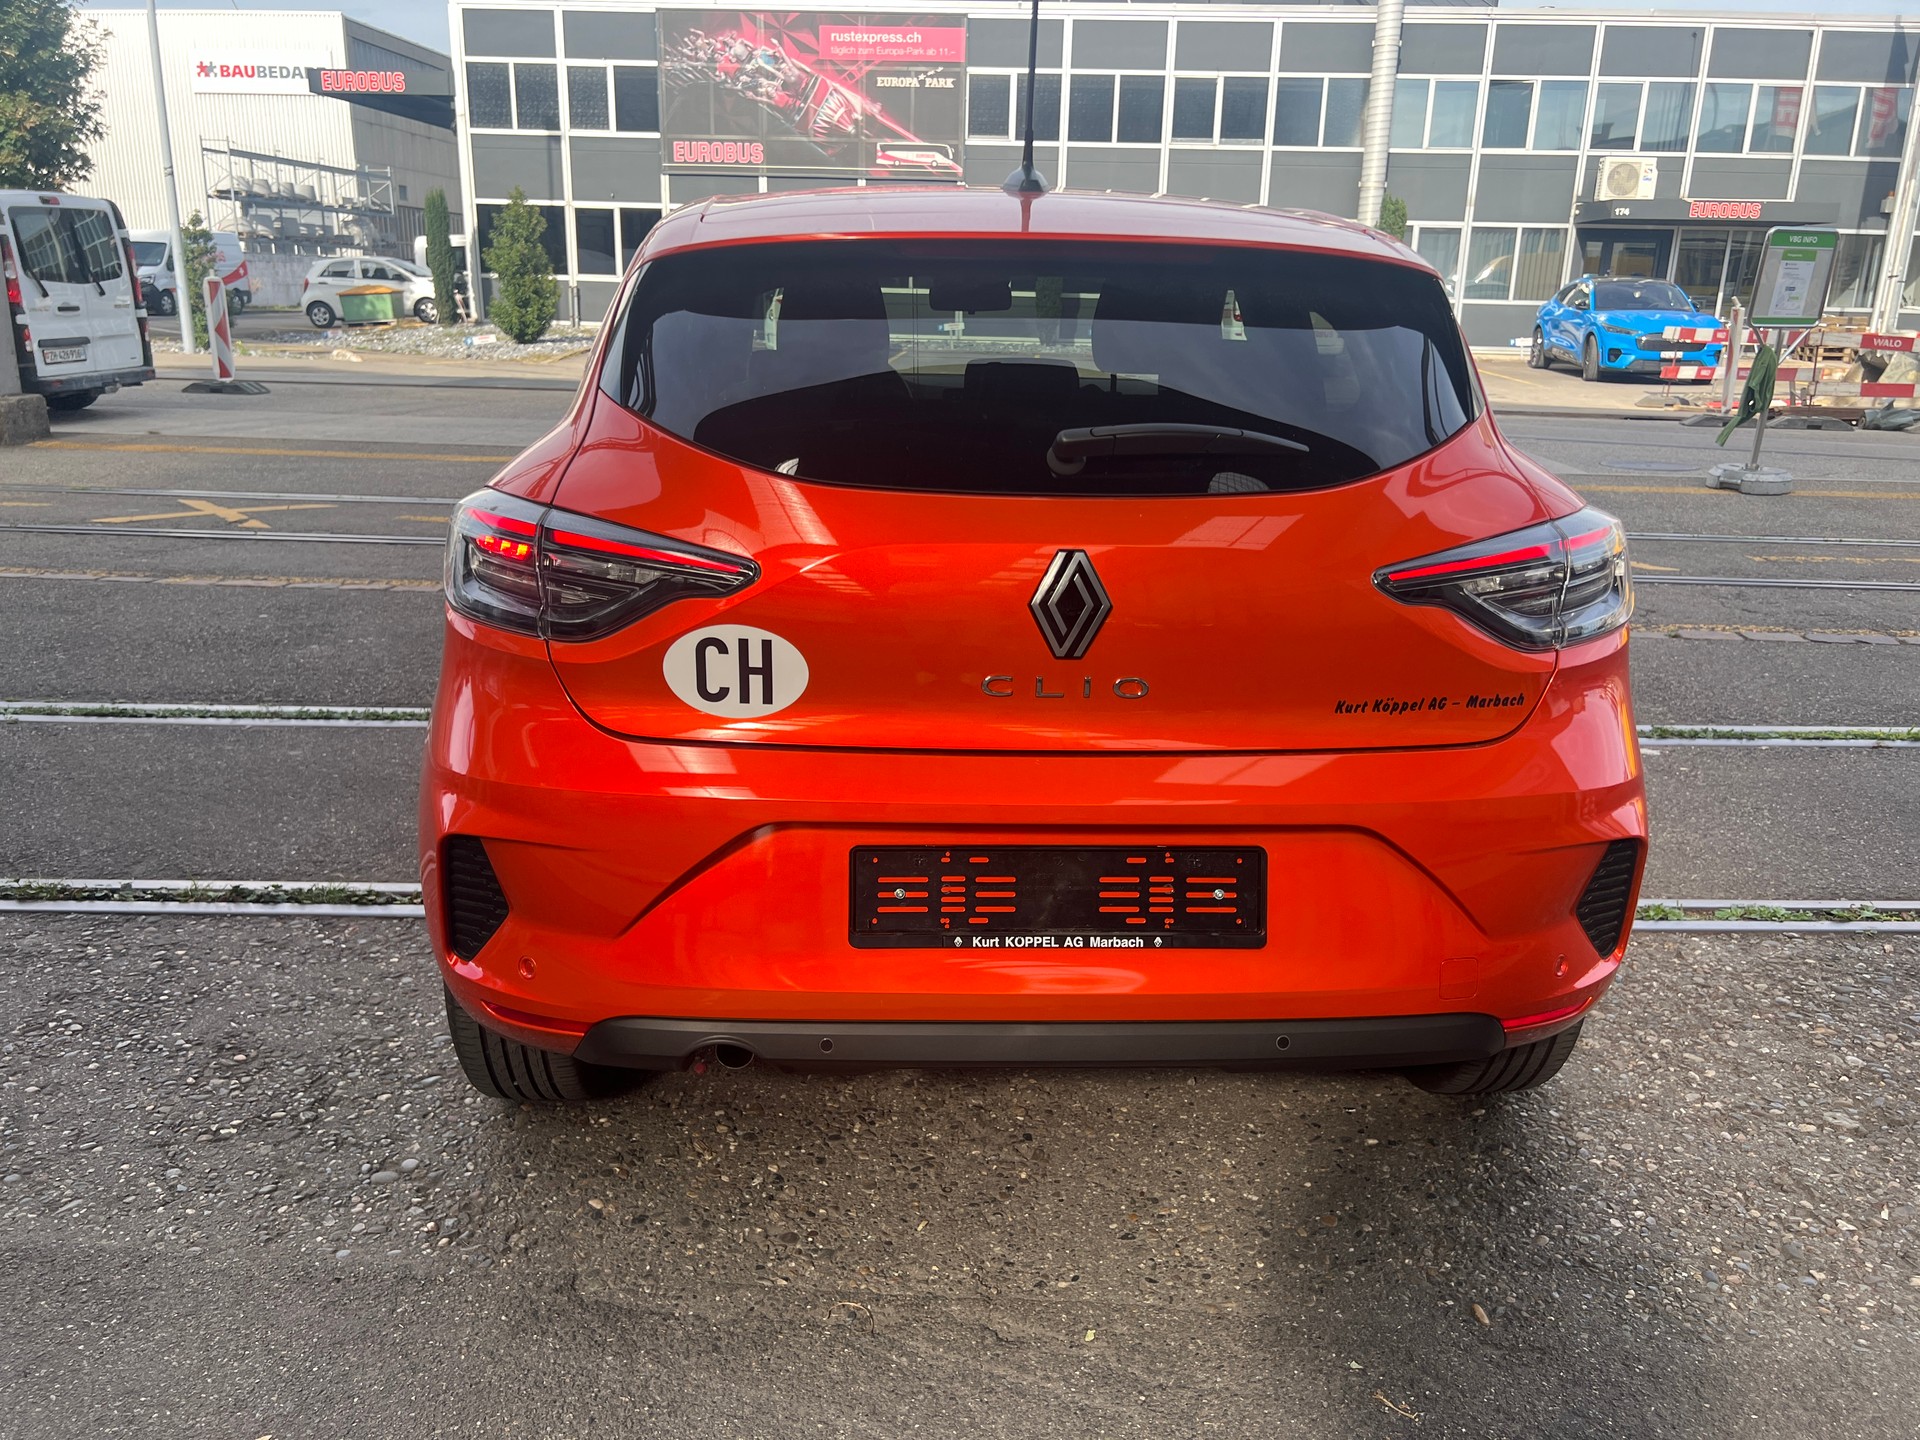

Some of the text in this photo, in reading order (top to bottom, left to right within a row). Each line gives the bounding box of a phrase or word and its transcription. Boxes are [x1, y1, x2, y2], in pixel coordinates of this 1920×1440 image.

[830, 31, 922, 45] rustexpress.ch
[830, 46, 856, 56] täglich
[876, 47, 924, 56] Europa-Park
[926, 48, 937, 56] ab
[320, 70, 406, 93] EUROBUS
[876, 77, 957, 88] EUROPA PARK
[672, 140, 765, 165] EUROBUS
[1614, 207, 1630, 216] 174
[1689, 201, 1762, 219] EUROBUS
[1789, 235, 1802, 243] VBG
[1873, 337, 1903, 348] WALO
[695, 637, 773, 705] CH
[981, 675, 1149, 699] CLIO
[1334, 700, 1368, 714] Kurt
[1371, 697, 1425, 716] Köppel
[1427, 697, 1448, 711] AG
[1465, 692, 1525, 709] Marbach
[972, 936, 1000, 948] Kurt
[1063, 936, 1084, 948] AG
[1089, 936, 1144, 948] Marbach
